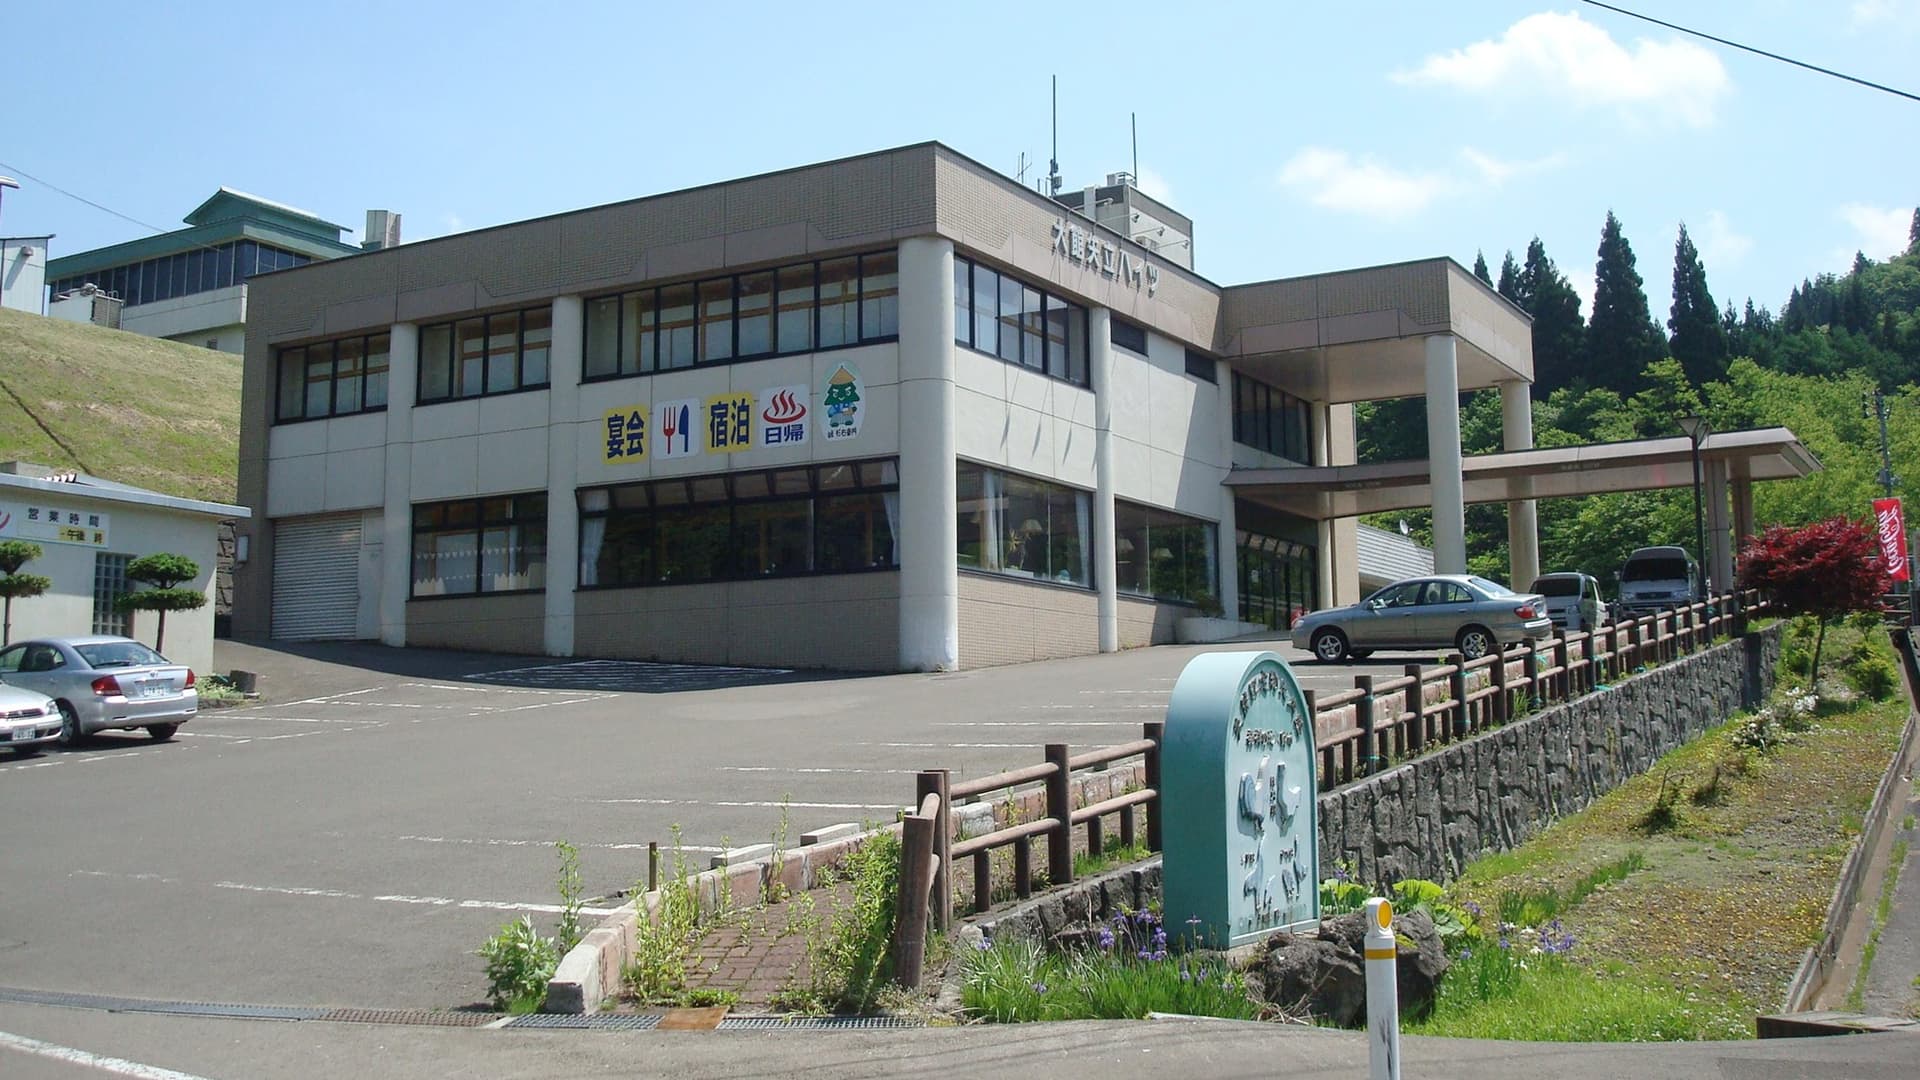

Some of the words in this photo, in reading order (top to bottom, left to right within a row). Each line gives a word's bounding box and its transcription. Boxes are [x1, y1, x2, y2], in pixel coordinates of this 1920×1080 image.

[606, 410, 646, 460] 宴会
[709, 397, 751, 449] 宿泊
[764, 423, 804, 445] 日帰
[28, 507, 100, 528] 営業時間
